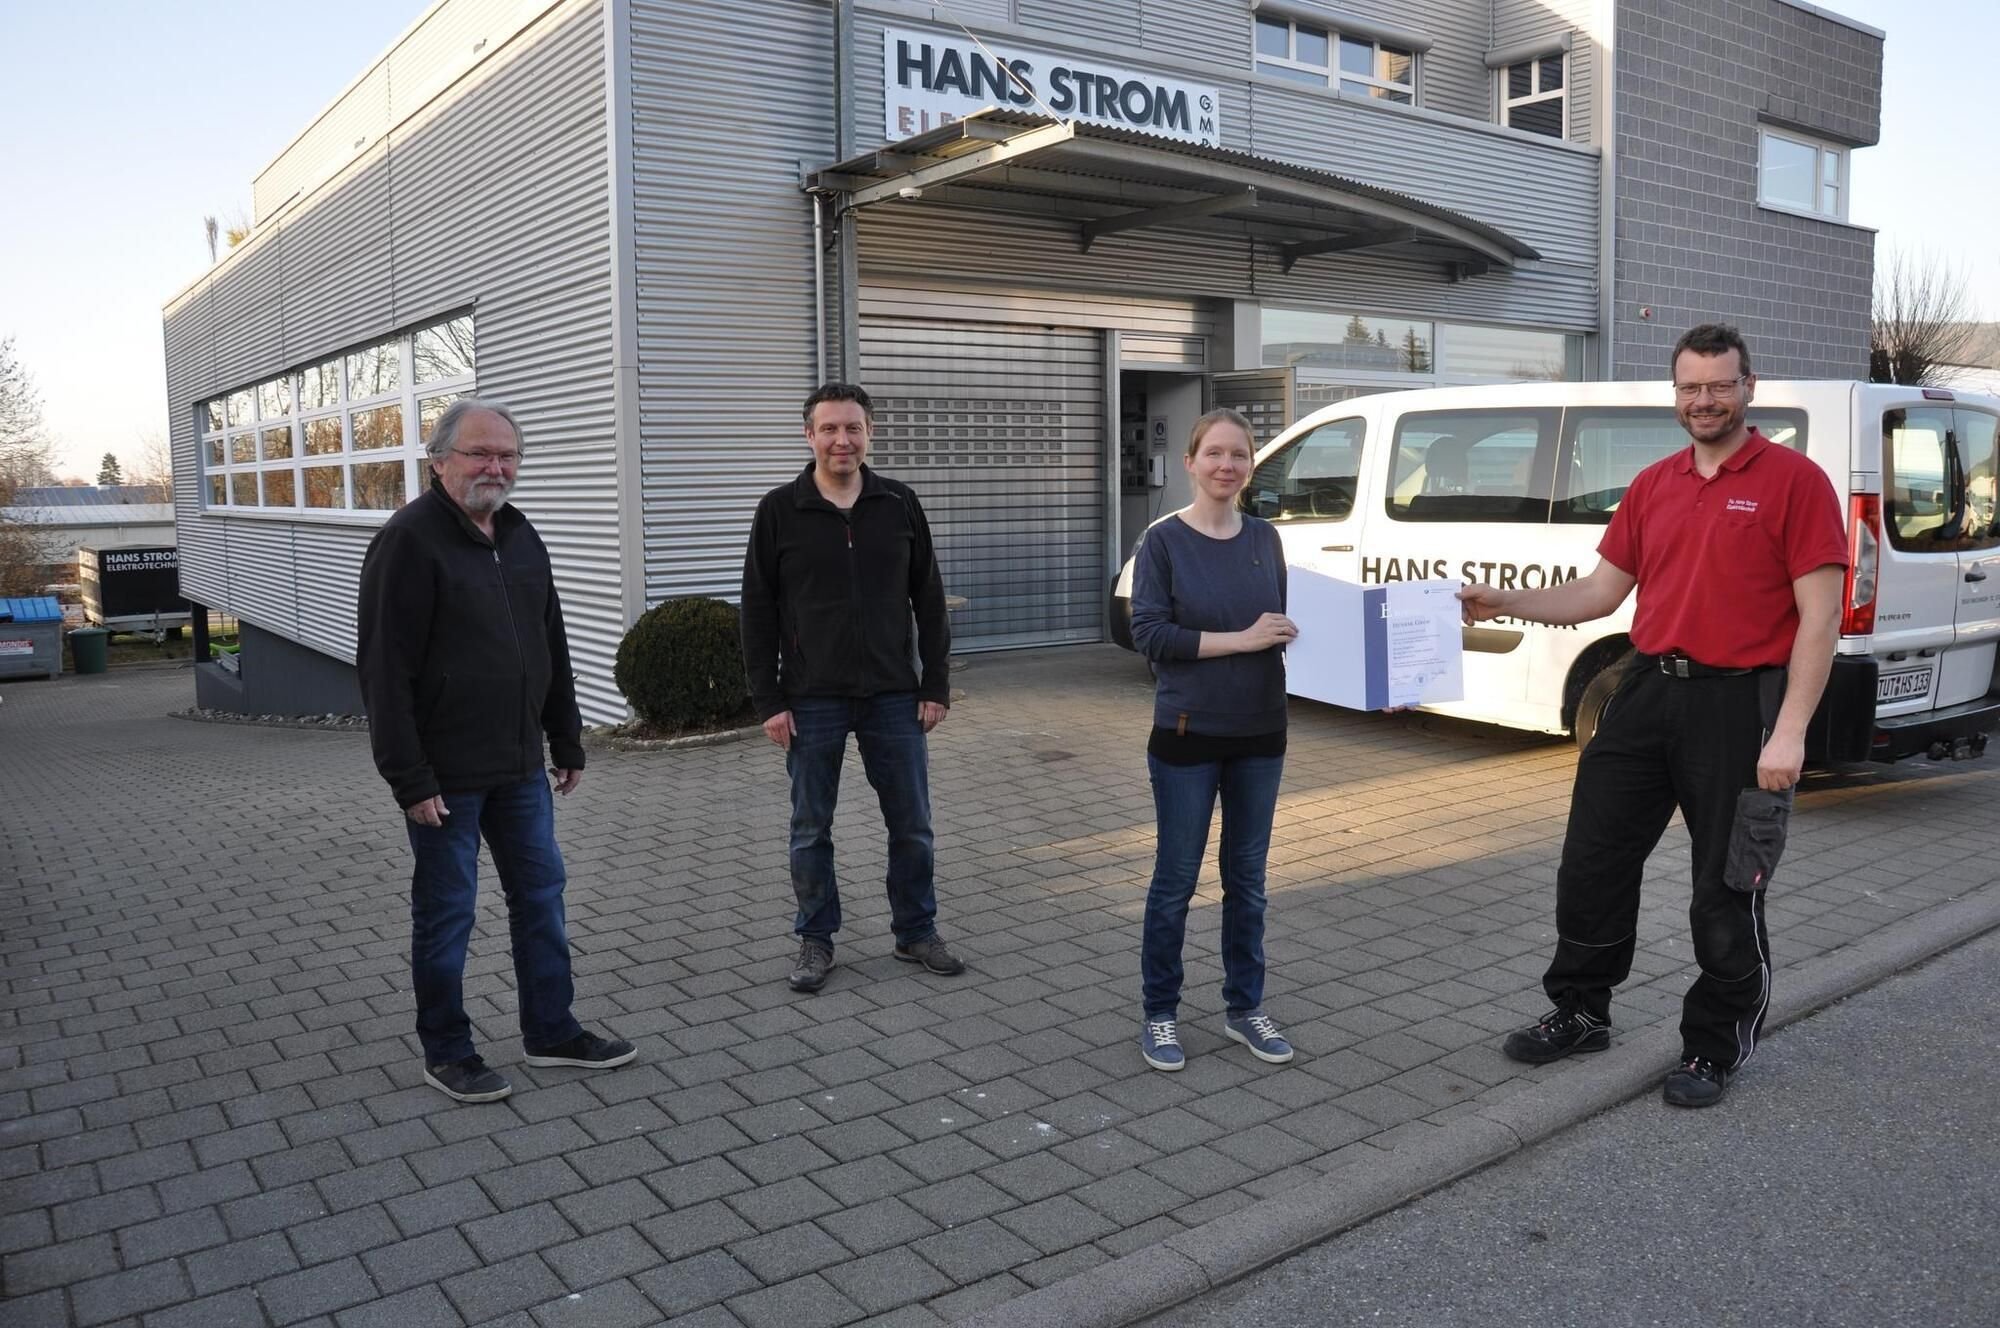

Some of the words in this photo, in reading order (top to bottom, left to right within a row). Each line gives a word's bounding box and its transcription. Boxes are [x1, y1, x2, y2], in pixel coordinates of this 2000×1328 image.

[896, 38, 1034, 106] HANS
[1049, 66, 1192, 134] STROM
[106, 553, 140, 563] HANS
[106, 561, 178, 572] ELEKTROTECHNI
[1361, 556, 1448, 583] HANS
[1460, 561, 1578, 590] STROM
[1878, 677, 1896, 698] TUT
[1900, 675, 1912, 694] HS
[1913, 672, 1930, 692] 133
